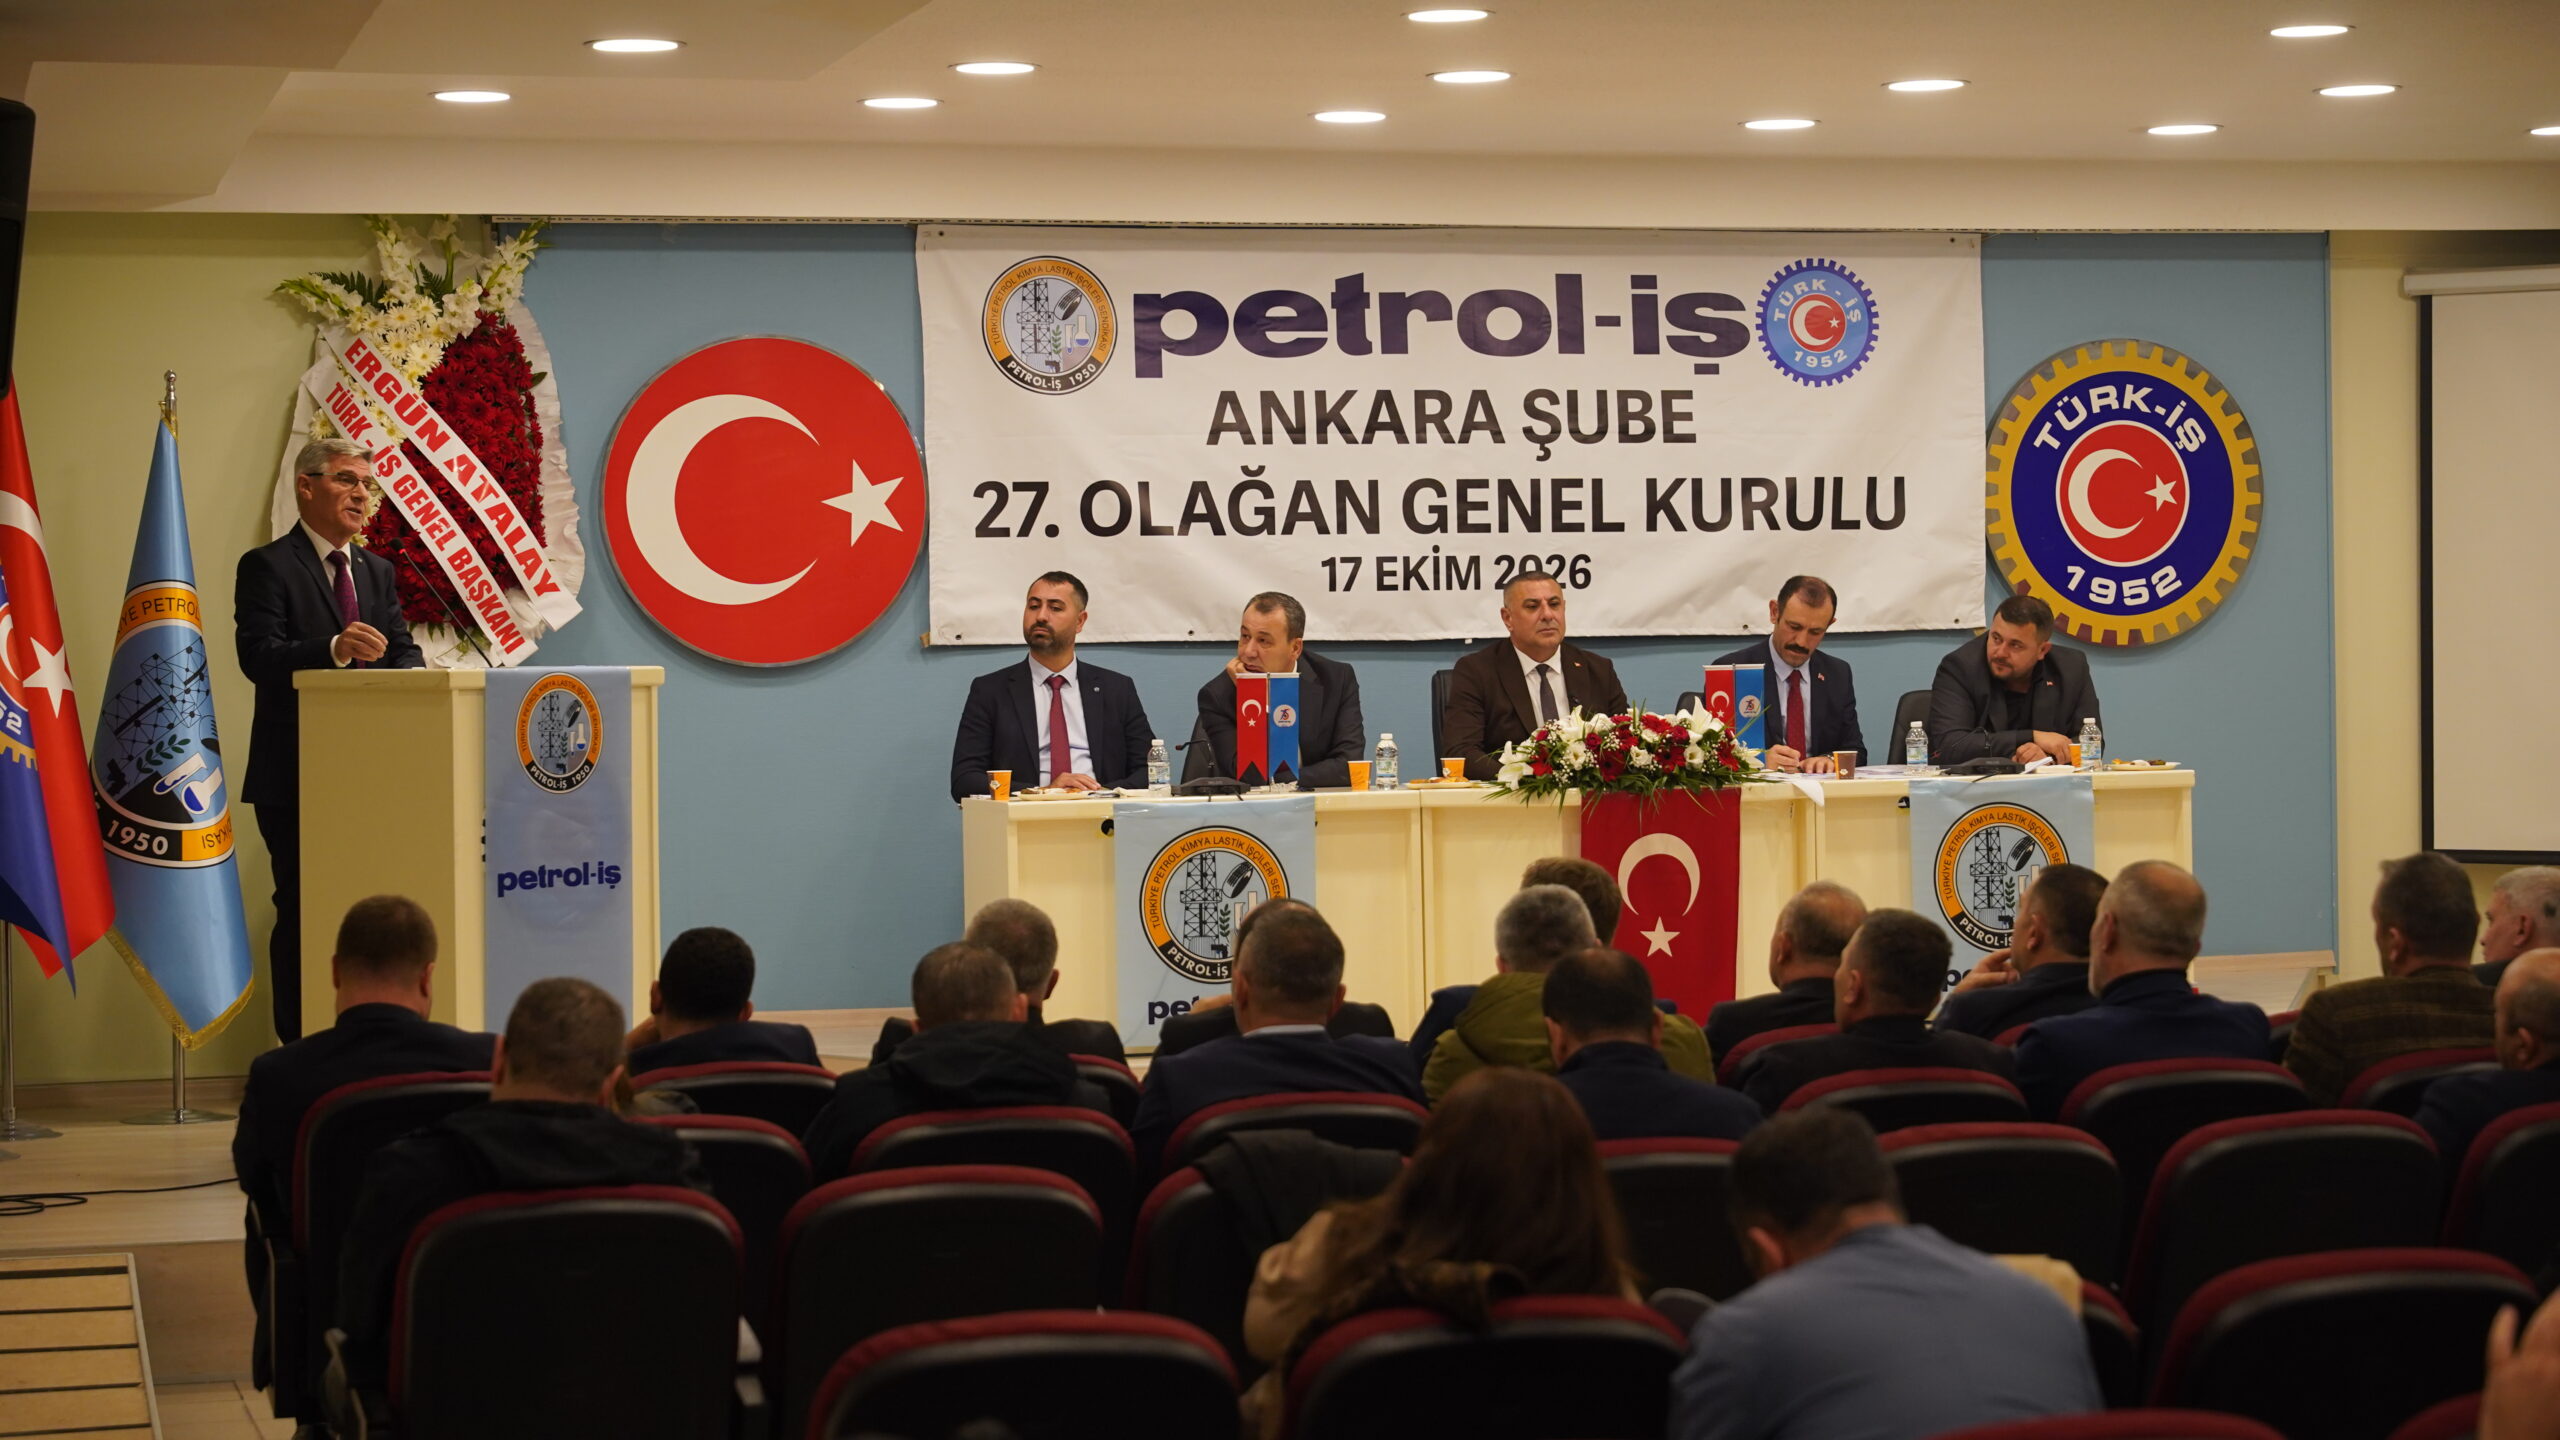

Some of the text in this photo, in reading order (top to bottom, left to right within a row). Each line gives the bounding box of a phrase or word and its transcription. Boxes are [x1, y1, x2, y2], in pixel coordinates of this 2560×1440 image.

[1016, 265, 1043, 278] KİMYA
[1045, 265, 1075, 277] LASTİK
[994, 279, 1016, 305] PETROL
[990, 306, 1001, 345] TÜRKİYE
[1133, 272, 1751, 378] petrol-iş
[1007, 361, 1097, 391] PETROL-İŞ 1950
[1794, 349, 1848, 368] 1952
[1206, 389, 1697, 462] ANKARA ŞUBE
[2033, 384, 2207, 452] TÜRK-İŞ
[344, 338, 561, 597] ERGÜN ATALAY
[973, 465, 1906, 538] 27. OLAĞAN GENEL KURULU
[392, 473, 459, 552] GENEL
[447, 547, 526, 655] BAŞKANI
[1321, 556, 1363, 592] 17
[1376, 545, 1482, 592] EKİM
[2067, 565, 2182, 606] 1952
[571, 765, 590, 785] 1950
[107, 819, 169, 856] 1950
[1941, 812, 2056, 901] TÜRKİYE PETROL KİMYA LASTİK İŞÇİLERİ
[497, 861, 622, 898] petrol-iş
[1149, 836, 1276, 929] TÜRKİYE PETROL KİMYA LASTİK İŞÇİLERİ
[1167, 946, 1229, 979] PETROL-İŞ
